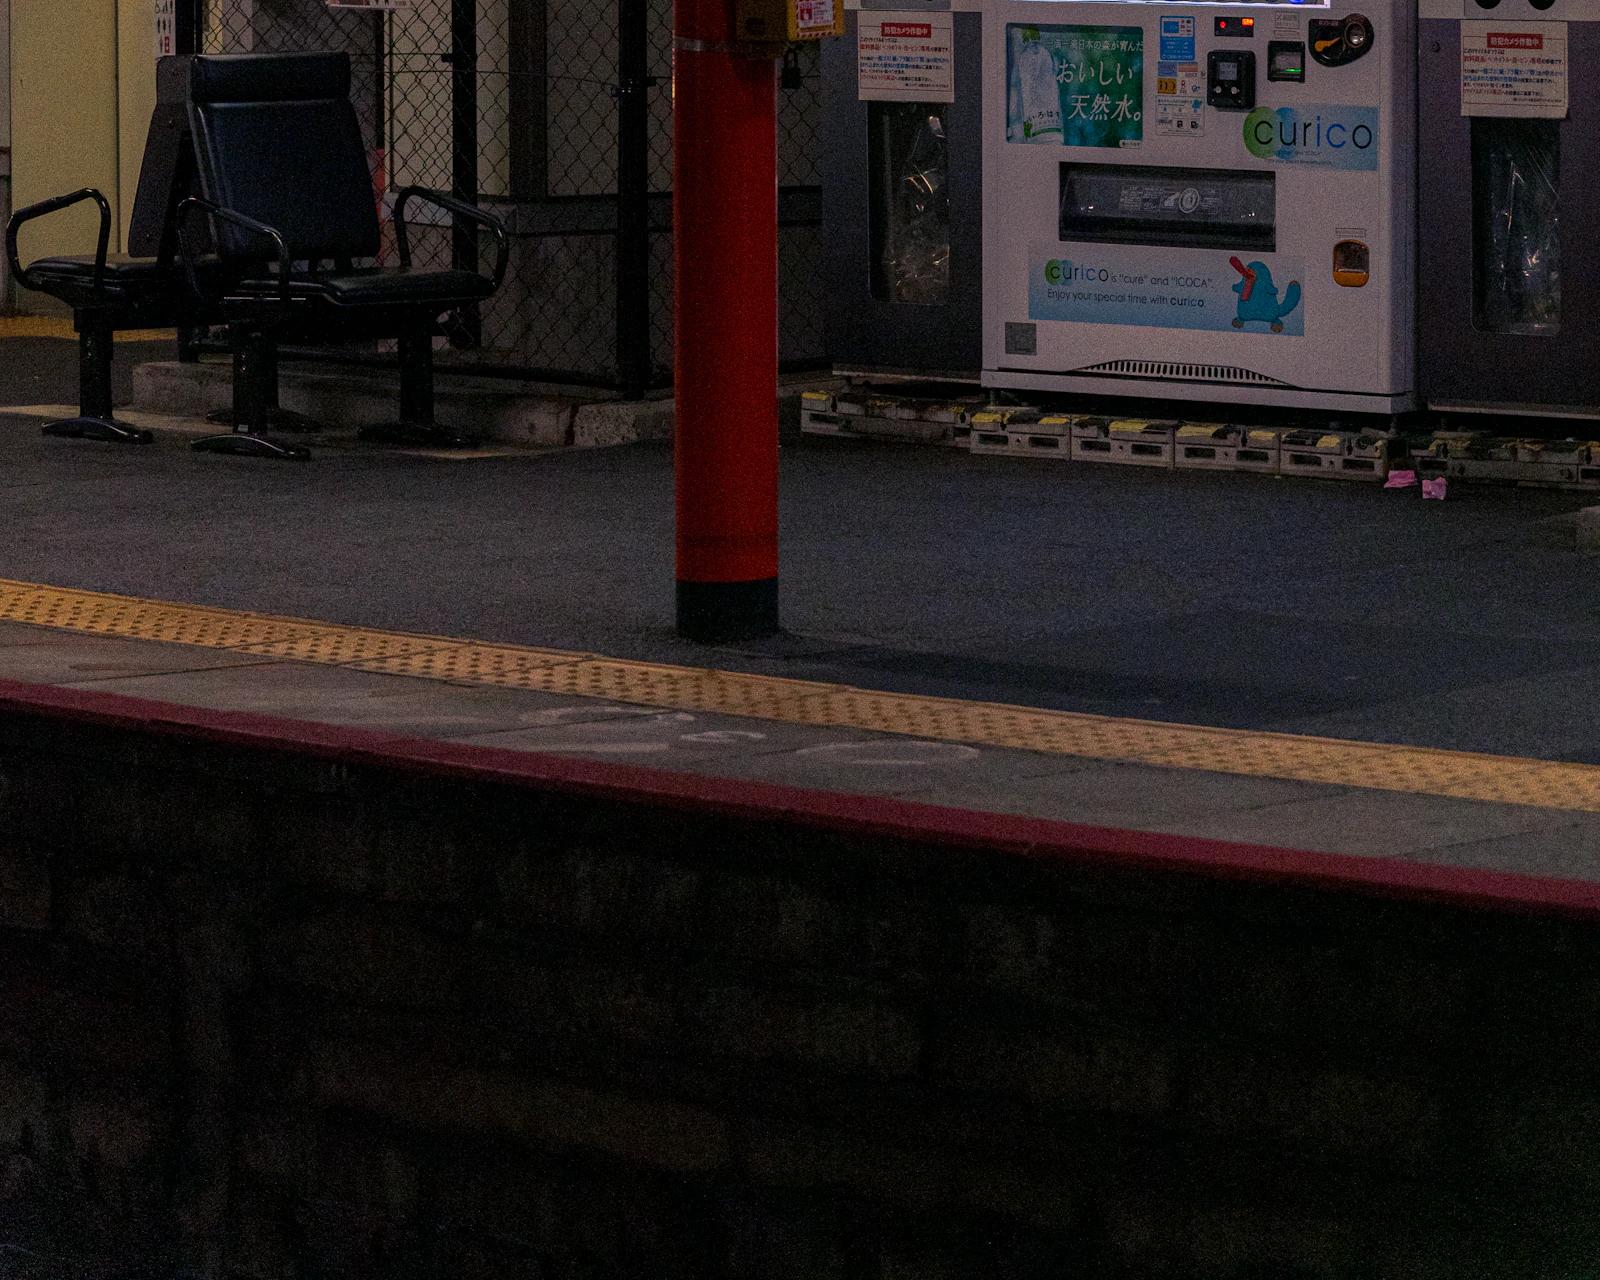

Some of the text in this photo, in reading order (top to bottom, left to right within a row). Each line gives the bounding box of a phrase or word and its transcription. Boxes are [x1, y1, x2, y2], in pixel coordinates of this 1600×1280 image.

[1056, 59, 1133, 86] おいしい
[1068, 94, 1141, 122] 天然水。
[1254, 116, 1372, 149] curico
[1050, 264, 1109, 282] curico
[1150, 276, 1168, 286] and
[1047, 289, 1071, 300] Enjoy
[1072, 291, 1092, 301] your
[1094, 291, 1126, 303] special
[1128, 293, 1147, 304] time
[1150, 295, 1167, 304] with
